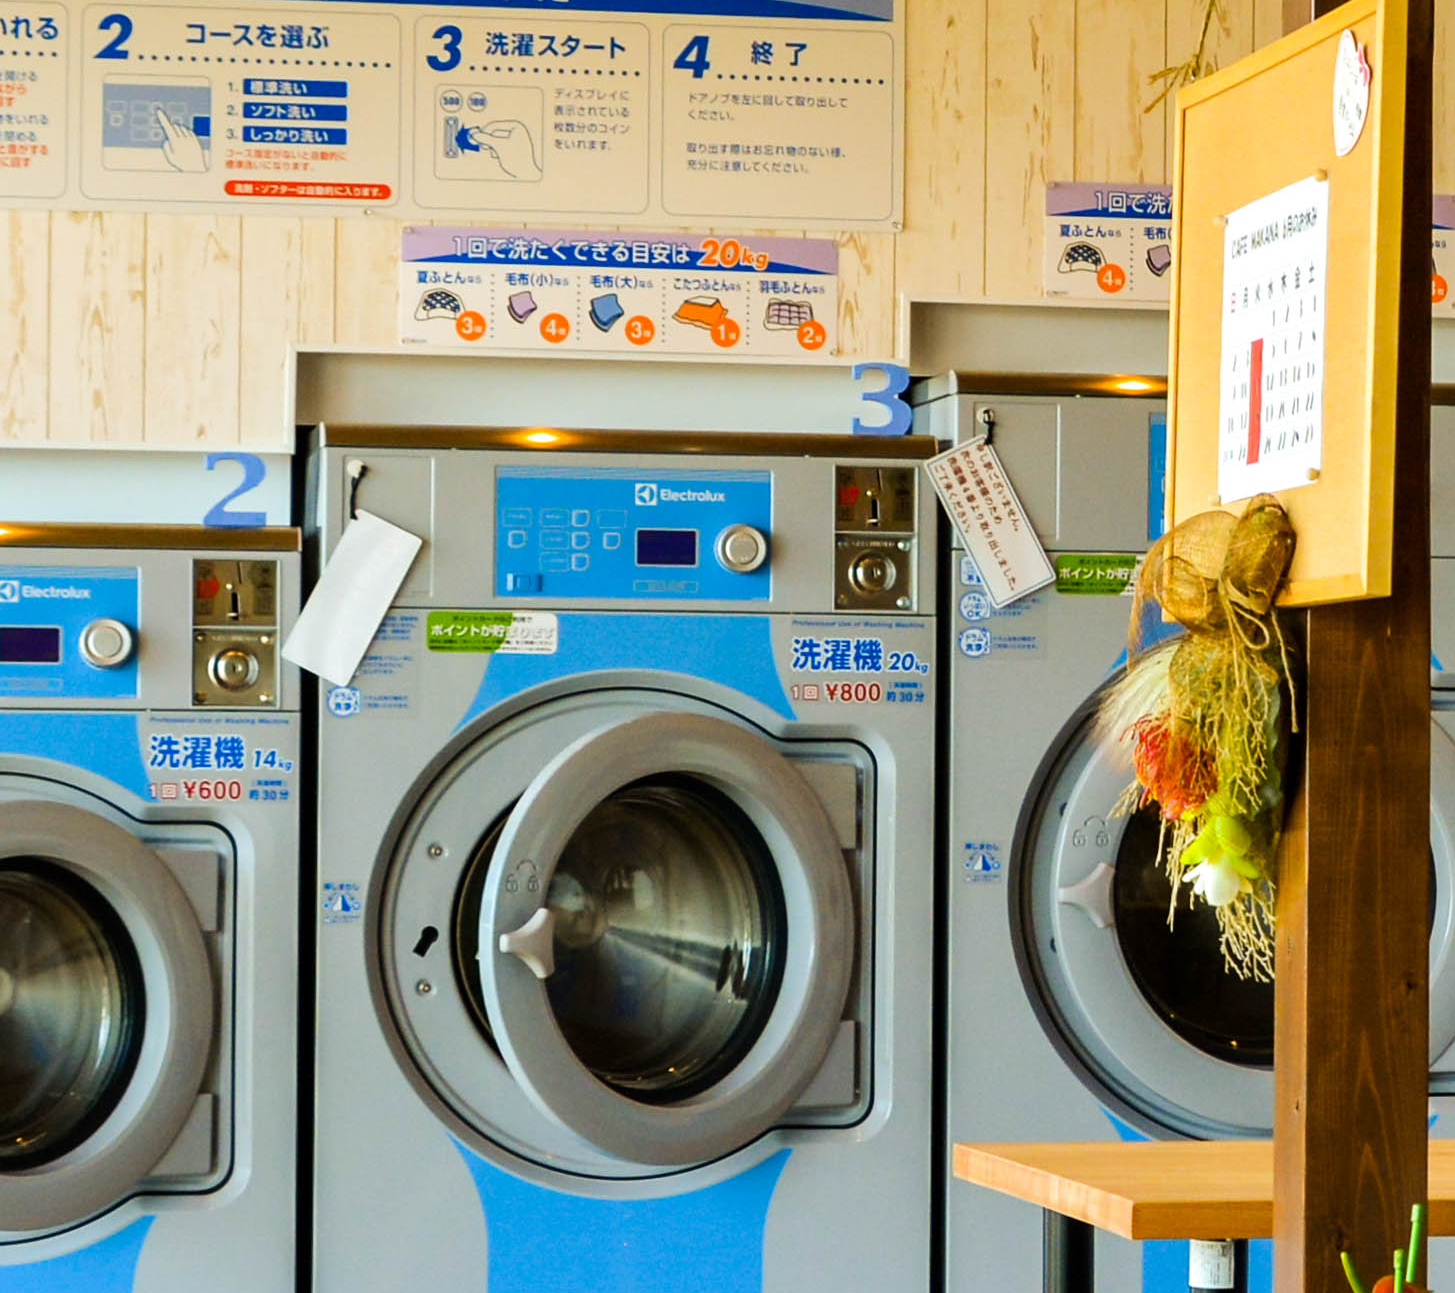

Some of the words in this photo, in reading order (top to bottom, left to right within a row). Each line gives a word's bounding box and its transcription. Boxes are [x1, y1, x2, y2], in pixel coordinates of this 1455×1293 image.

[94, 14, 135, 60] 2
[185, 22, 329, 51] コースを選ぶ
[426, 24, 462, 73] 3
[484, 31, 627, 60] 洗濯スタート
[673, 35, 711, 80] 4
[751, 41, 808, 67] 終了
[553, 105, 630, 118] 表示されている
[687, 110, 735, 121] ください。
[250, 127, 329, 143] しっかり洗い
[553, 122, 630, 134] 枚数分のコイン
[451, 236, 690, 264] 1回で洗たくできる目安は
[696, 238, 769, 270] 20kg
[851, 363, 913, 435] 3
[203, 452, 267, 528] 2
[660, 487, 726, 503] Electrolux
[22, 584, 91, 600] Electrolux
[793, 638, 882, 671] 洗濯機
[888, 653, 929, 673] 20kg
[825, 683, 881, 702] ¥800
[150, 735, 245, 770] 洗濯機
[254, 749, 292, 772] 14kg
[183, 781, 242, 800] ¥600
